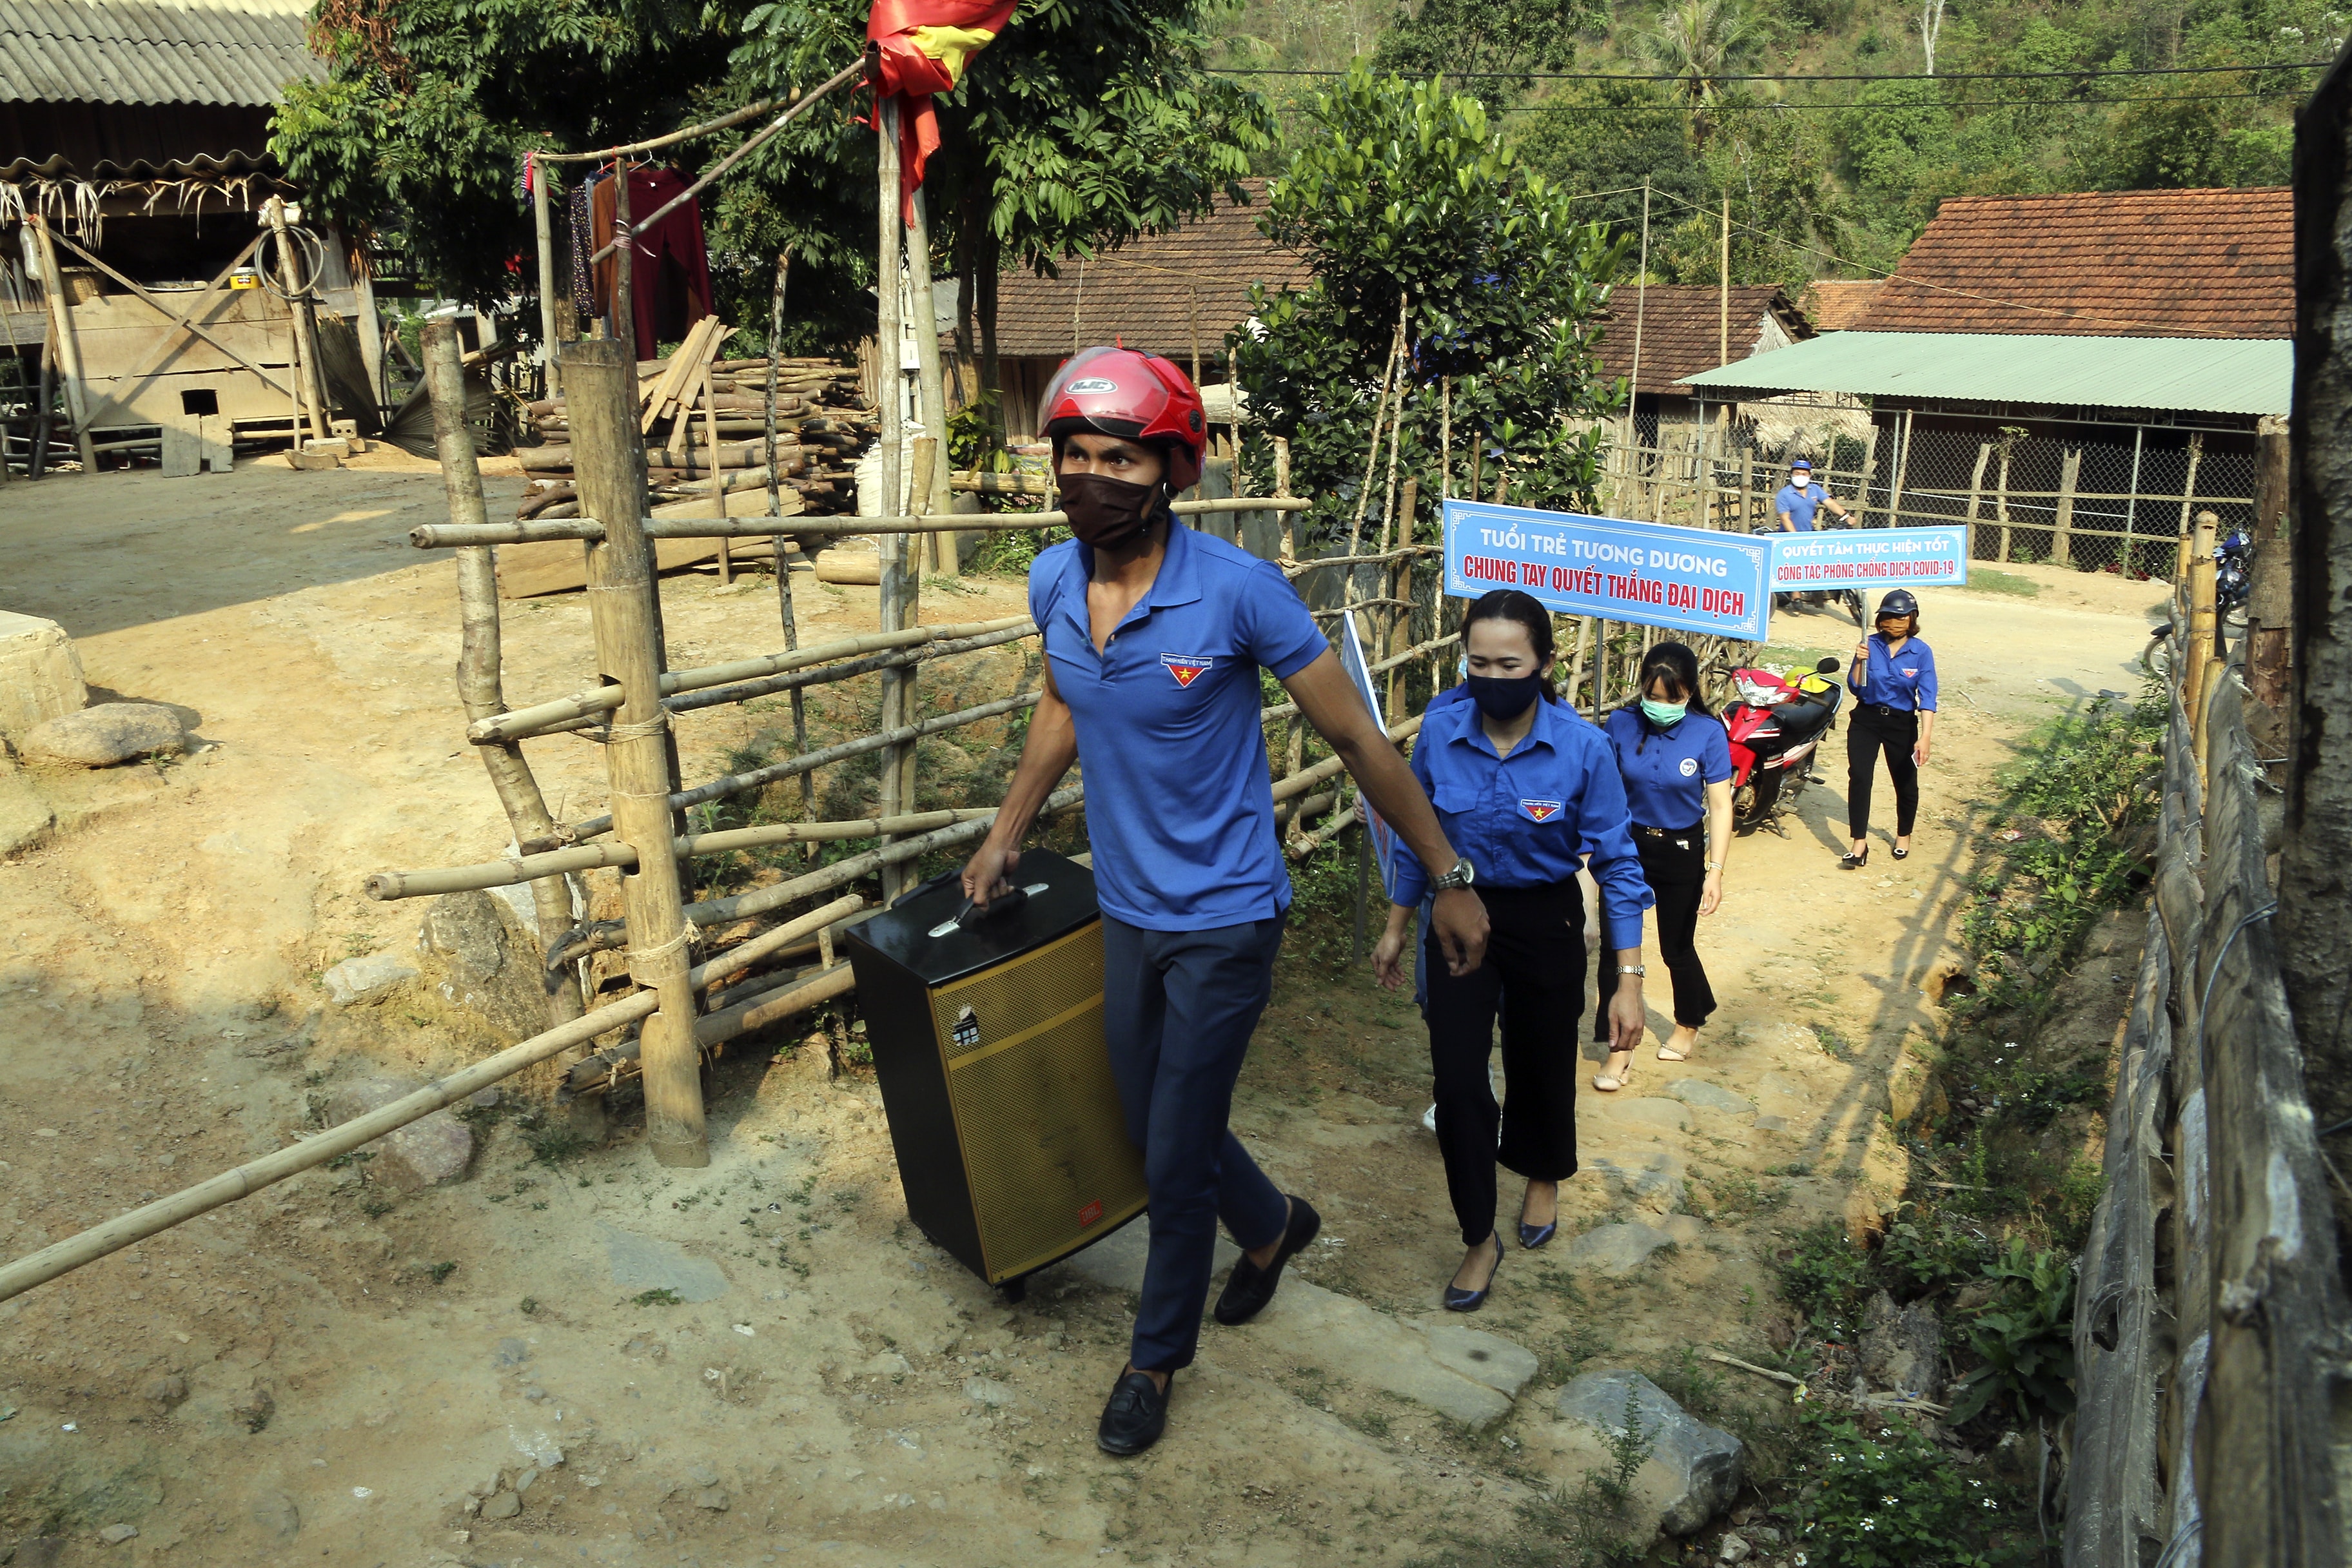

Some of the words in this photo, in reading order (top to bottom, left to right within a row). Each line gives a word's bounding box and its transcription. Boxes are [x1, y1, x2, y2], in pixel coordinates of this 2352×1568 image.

[1071, 381, 1108, 390] HJC
[1480, 523, 1526, 551] TUỔI
[1531, 533, 1567, 556] TRẺ
[1574, 540, 1644, 567] TƯƠNG
[1649, 549, 1727, 577] DƯƠNG
[1782, 540, 1825, 558] QUYẾT
[1827, 541, 1854, 556] TÂM
[1856, 542, 1890, 558] THỰC
[1892, 539, 1921, 556] HIỆN
[1924, 536, 1950, 552] TỐT
[1778, 562, 1802, 581] CÔNG
[1804, 562, 1821, 580] TÁC
[1823, 560, 1854, 579] PHÒNG
[1857, 556, 1887, 578] CHỐNG
[1890, 561, 1910, 580] DỊCH
[1914, 560, 1954, 575] COVID-19
[1463, 554, 1517, 584] CHUNG
[1521, 563, 1548, 588] TAY
[1552, 565, 1603, 596] QUYẾT
[1607, 569, 1664, 605] THẮNG
[1667, 582, 1698, 614] ĐẠI
[1702, 587, 1745, 618] DỊCH
[1083, 1206, 1100, 1222] JBL
